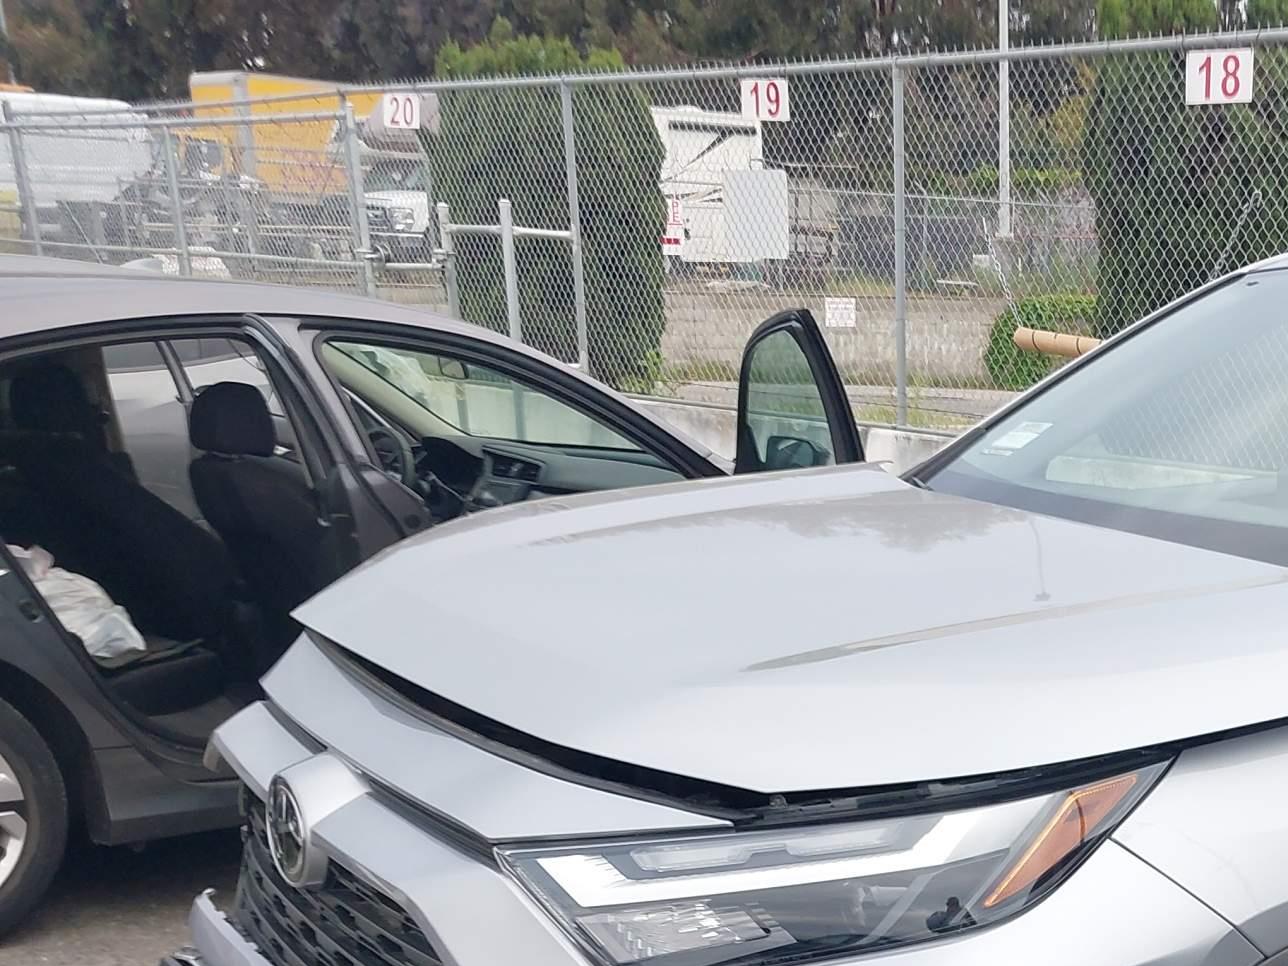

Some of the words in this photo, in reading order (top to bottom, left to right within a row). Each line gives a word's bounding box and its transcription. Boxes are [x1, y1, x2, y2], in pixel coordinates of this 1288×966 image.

[1199, 55, 1240, 98] 18
[390, 96, 413, 126] 20
[751, 81, 780, 117] 19
